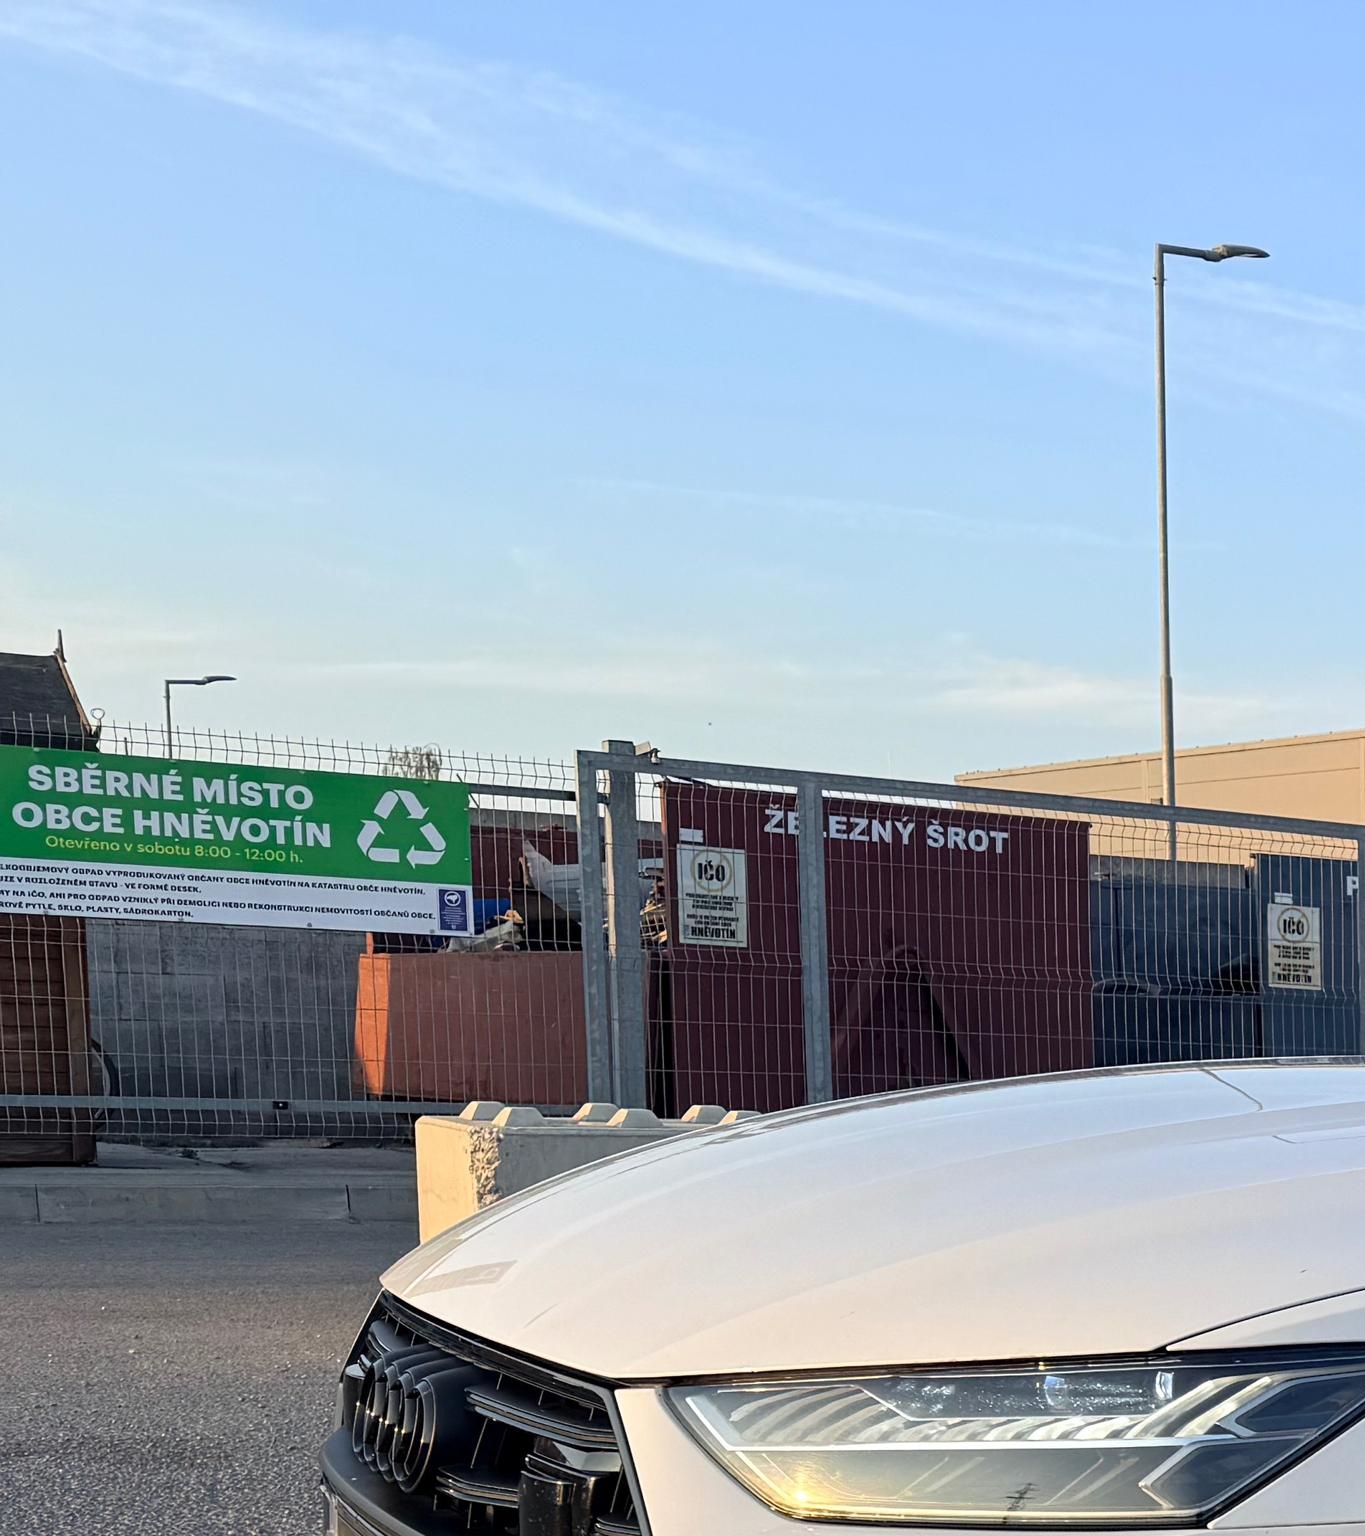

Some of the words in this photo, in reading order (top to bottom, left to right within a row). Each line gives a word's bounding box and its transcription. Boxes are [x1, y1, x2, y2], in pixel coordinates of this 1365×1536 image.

[27, 762, 184, 801] SBĚRNÉ
[192, 774, 314, 810] MÍSTO
[12, 801, 125, 834] OBCE
[133, 808, 331, 848] HNĚVOTÍN
[764, 803, 915, 845] ŽEEZNÝ
[927, 819, 1009, 854] ŠROT
[45, 835, 120, 852] Otevřeno
[124, 843, 133, 852] v
[137, 841, 191, 857] sobotu
[194, 845, 231, 858] 8:00
[243, 848, 286, 862] 12:00
[289, 851, 304, 863] h.
[72, 867, 103, 876] ODPAD
